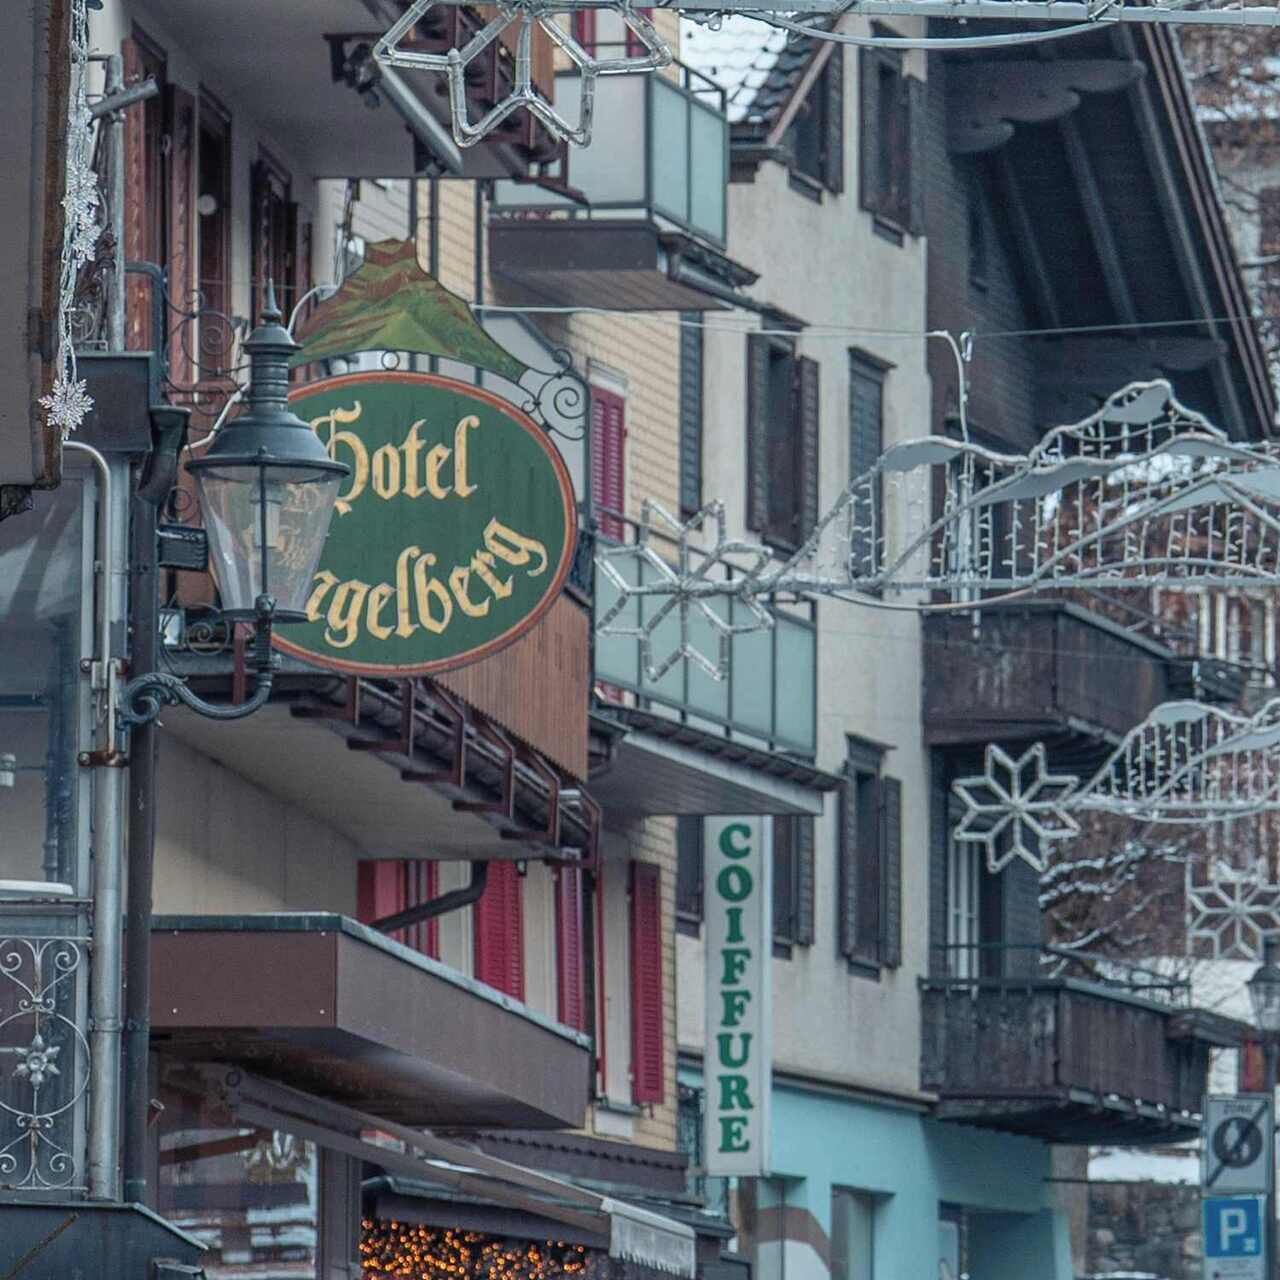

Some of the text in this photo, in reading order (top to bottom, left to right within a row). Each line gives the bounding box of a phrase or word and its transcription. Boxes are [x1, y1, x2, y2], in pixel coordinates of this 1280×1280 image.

[310, 400, 480, 516] Hotel
[716, 822, 754, 1154] COIFFURE
[1220, 1208, 1247, 1251] P
